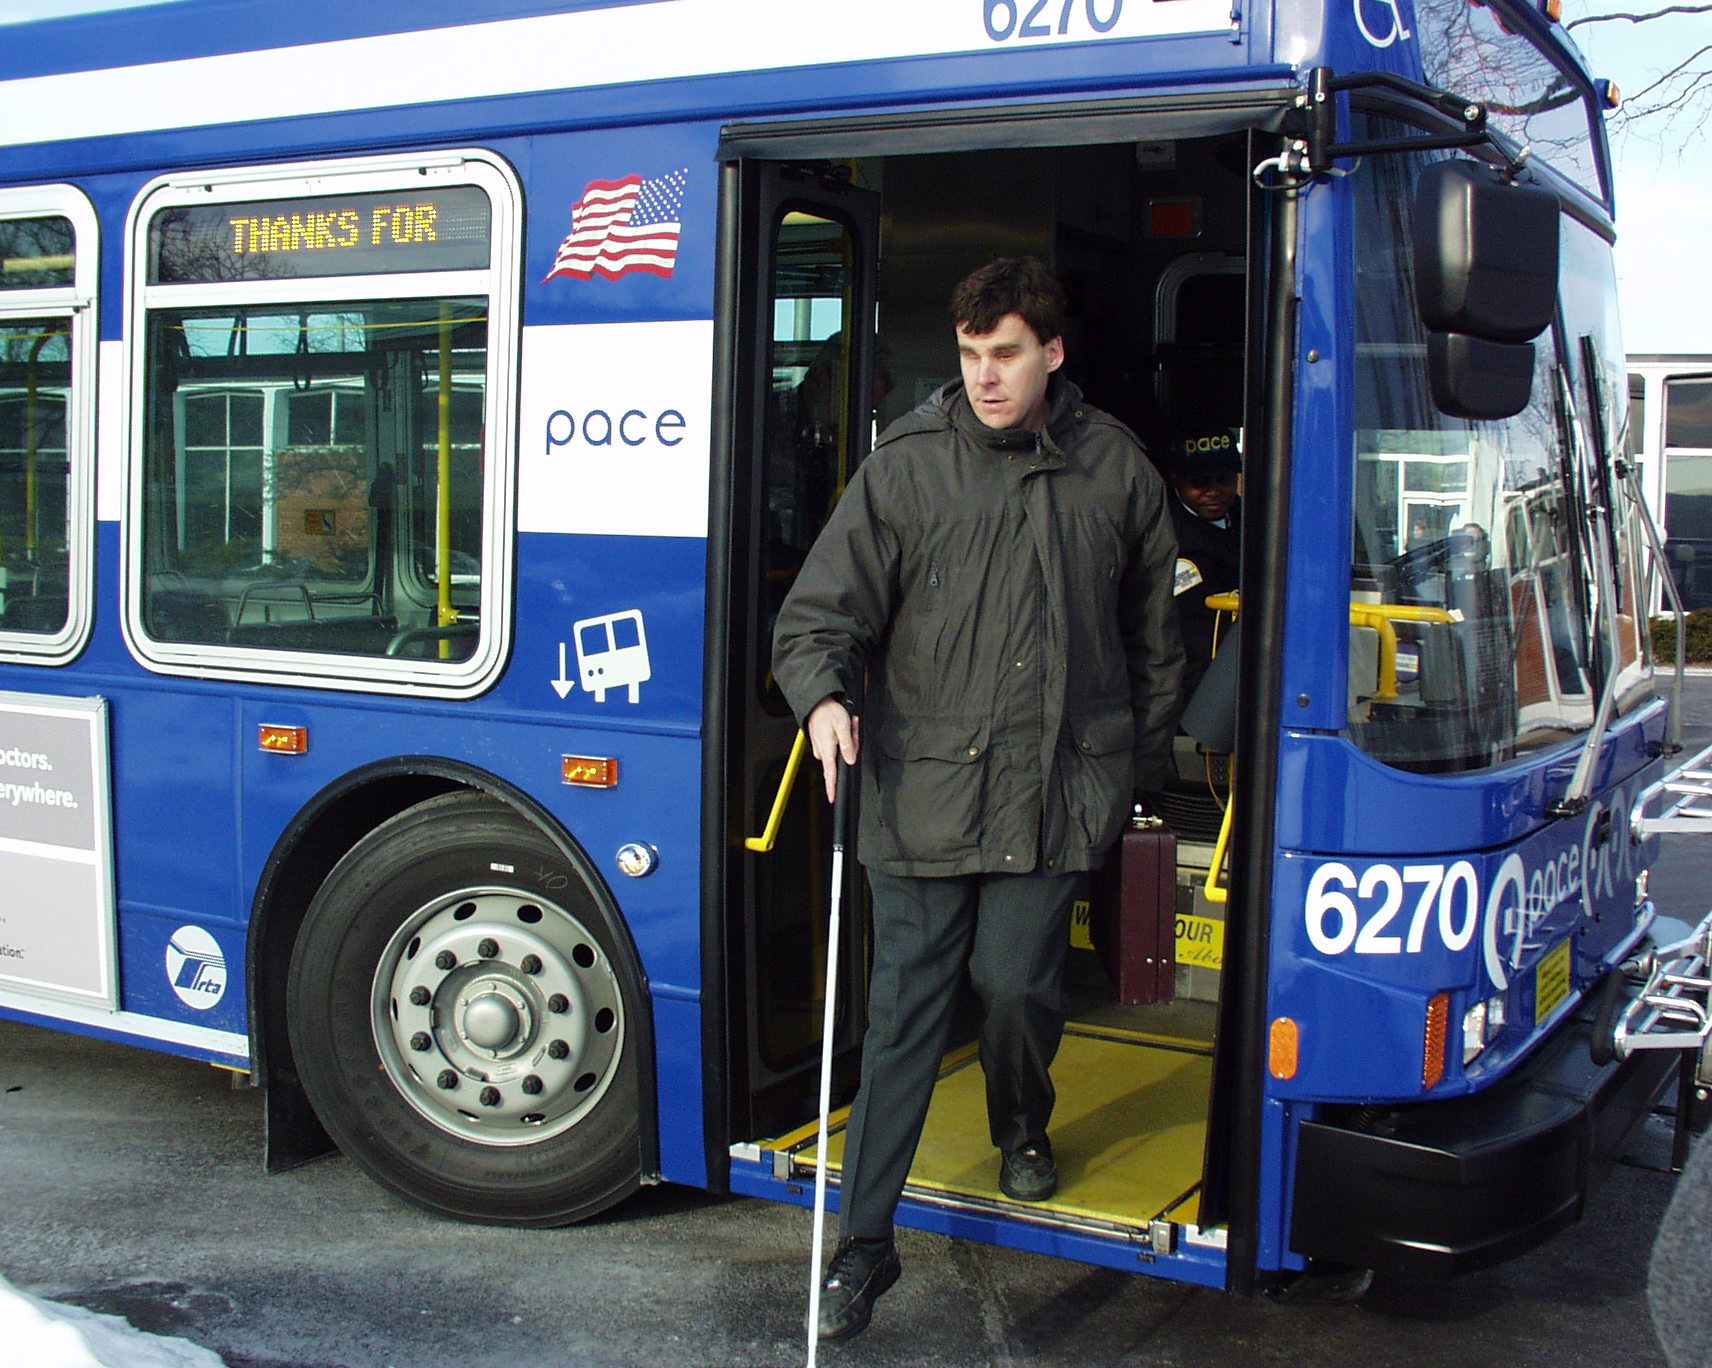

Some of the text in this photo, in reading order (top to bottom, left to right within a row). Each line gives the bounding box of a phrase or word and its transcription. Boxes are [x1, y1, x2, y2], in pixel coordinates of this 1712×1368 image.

[229, 202, 437, 254] THANKS FOR
[546, 408, 687, 455] pace
[1185, 433, 1230, 456] pace
[1174, 918, 1213, 944] OUR
[1305, 860, 1479, 956] 6270
